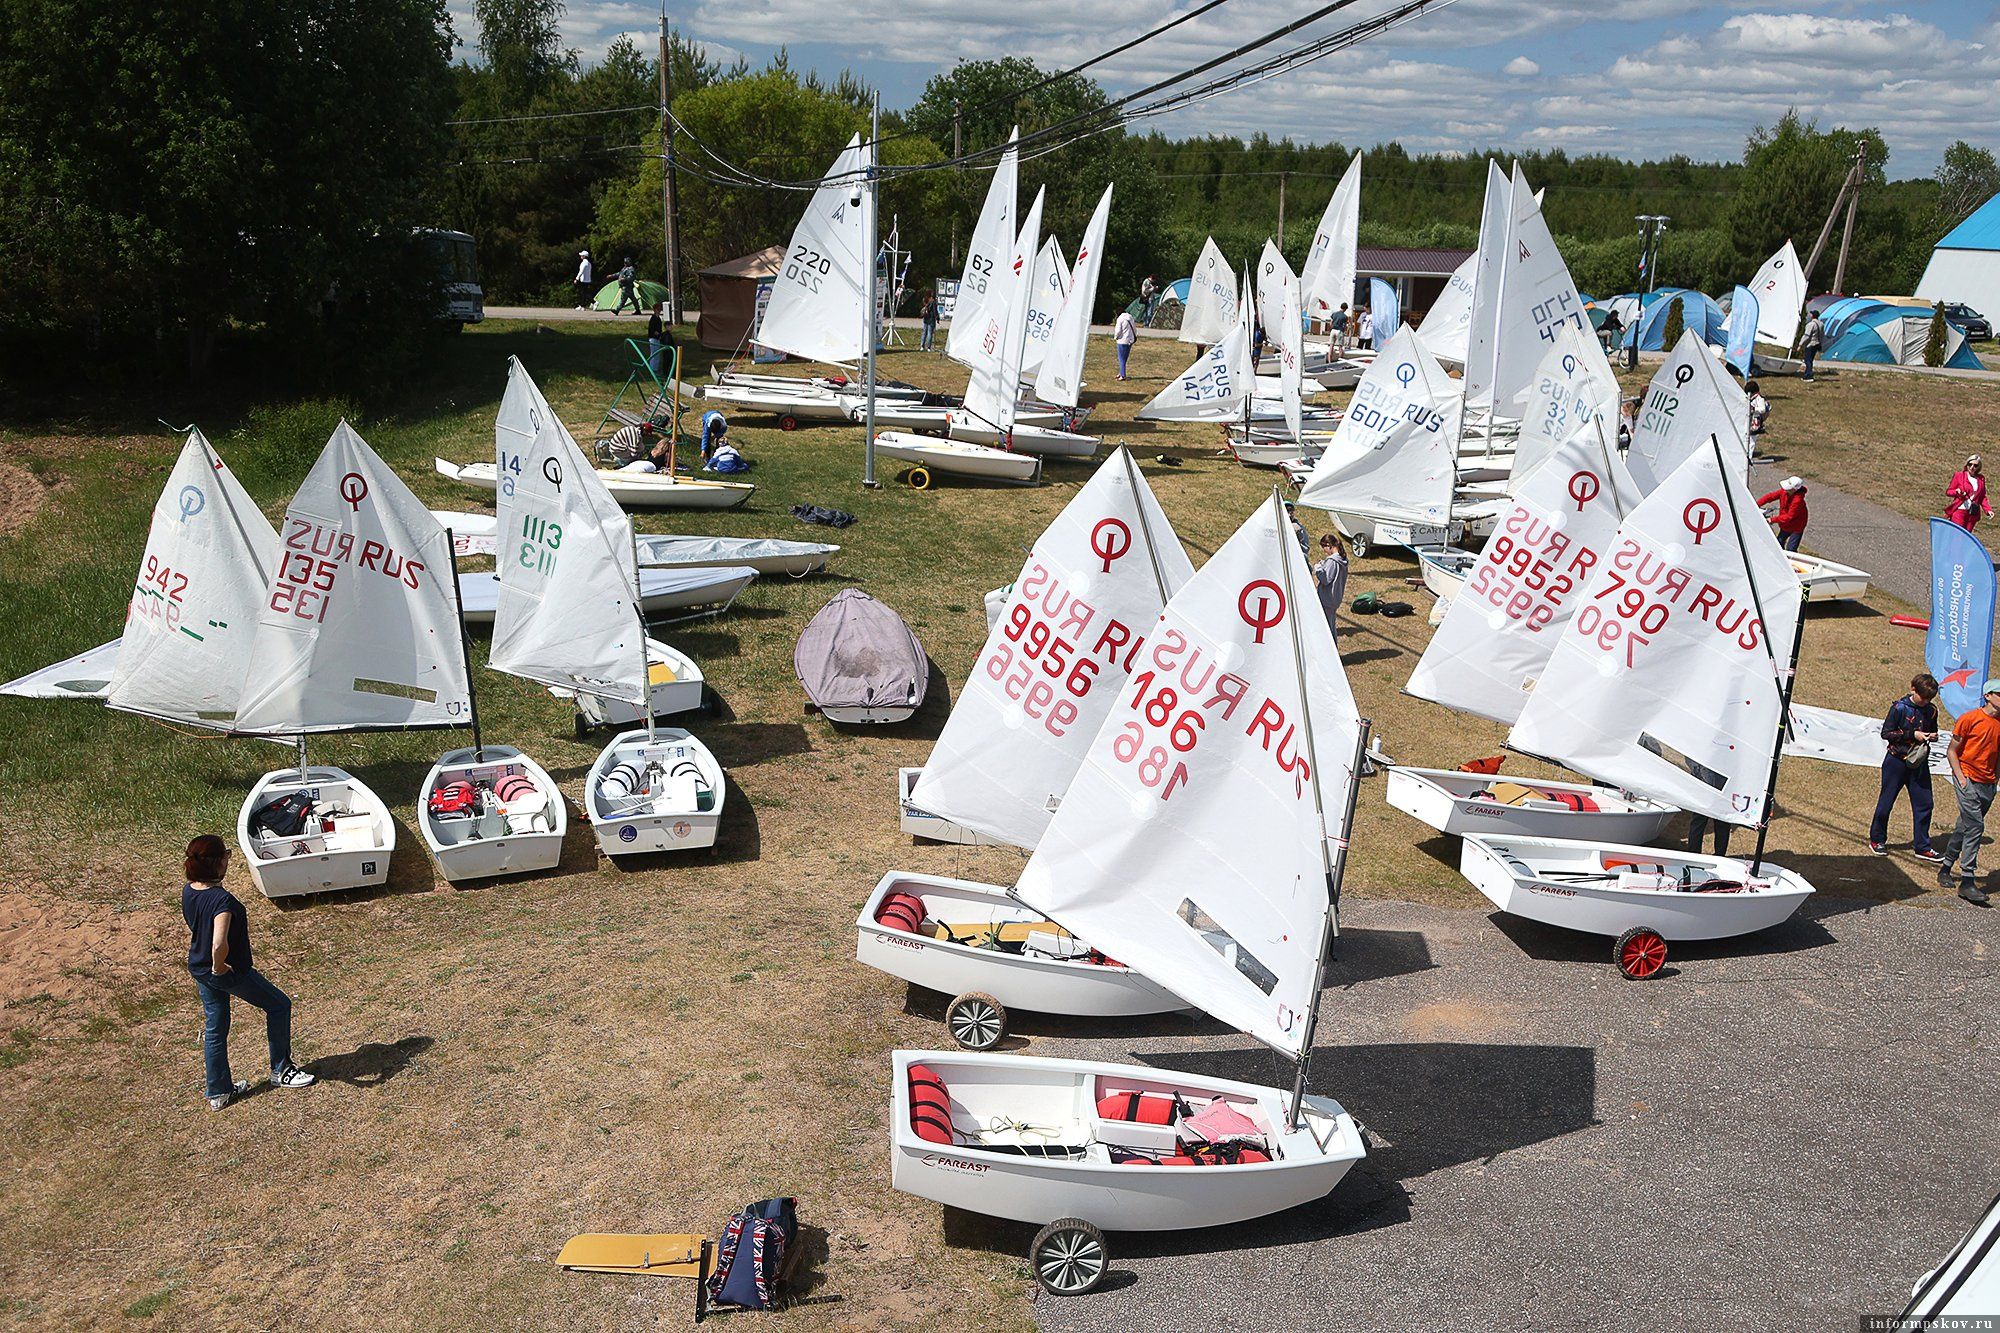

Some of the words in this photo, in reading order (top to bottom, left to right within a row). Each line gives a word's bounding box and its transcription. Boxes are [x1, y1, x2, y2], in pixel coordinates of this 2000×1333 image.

[793, 245, 830, 275] 220
[972, 254, 993, 277] 62
[1212, 283, 1234, 300] RUS
[1766, 280, 1776, 291] 2
[1028, 309, 1054, 330] 954
[1183, 376, 1200, 401] 147
[1213, 364, 1231, 398] RUS
[1351, 403, 1400, 433] 6017
[1401, 403, 1445, 433] RUS
[1547, 402, 1566, 426] 32
[1574, 398, 1604, 424] RU
[1650, 390, 1679, 417] 1112
[502, 451, 526, 475] 14
[523, 514, 562, 550] 1113
[145, 555, 188, 602] 942
[278, 551, 338, 592] 135
[359, 540, 425, 589] RUS
[1490, 535, 1573, 606] 9952
[1594, 570, 1670, 635] 790
[1688, 582, 1766, 651] RUS
[1004, 603, 1100, 698] 9956
[1093, 619, 1146, 675] RU
[1130, 670, 1206, 753] 186
[1245, 697, 1310, 800] RUS
[1540, 886, 1577, 897] FAREAST
[887, 936, 925, 951] FAREAST
[938, 1157, 990, 1173] FAREAST
